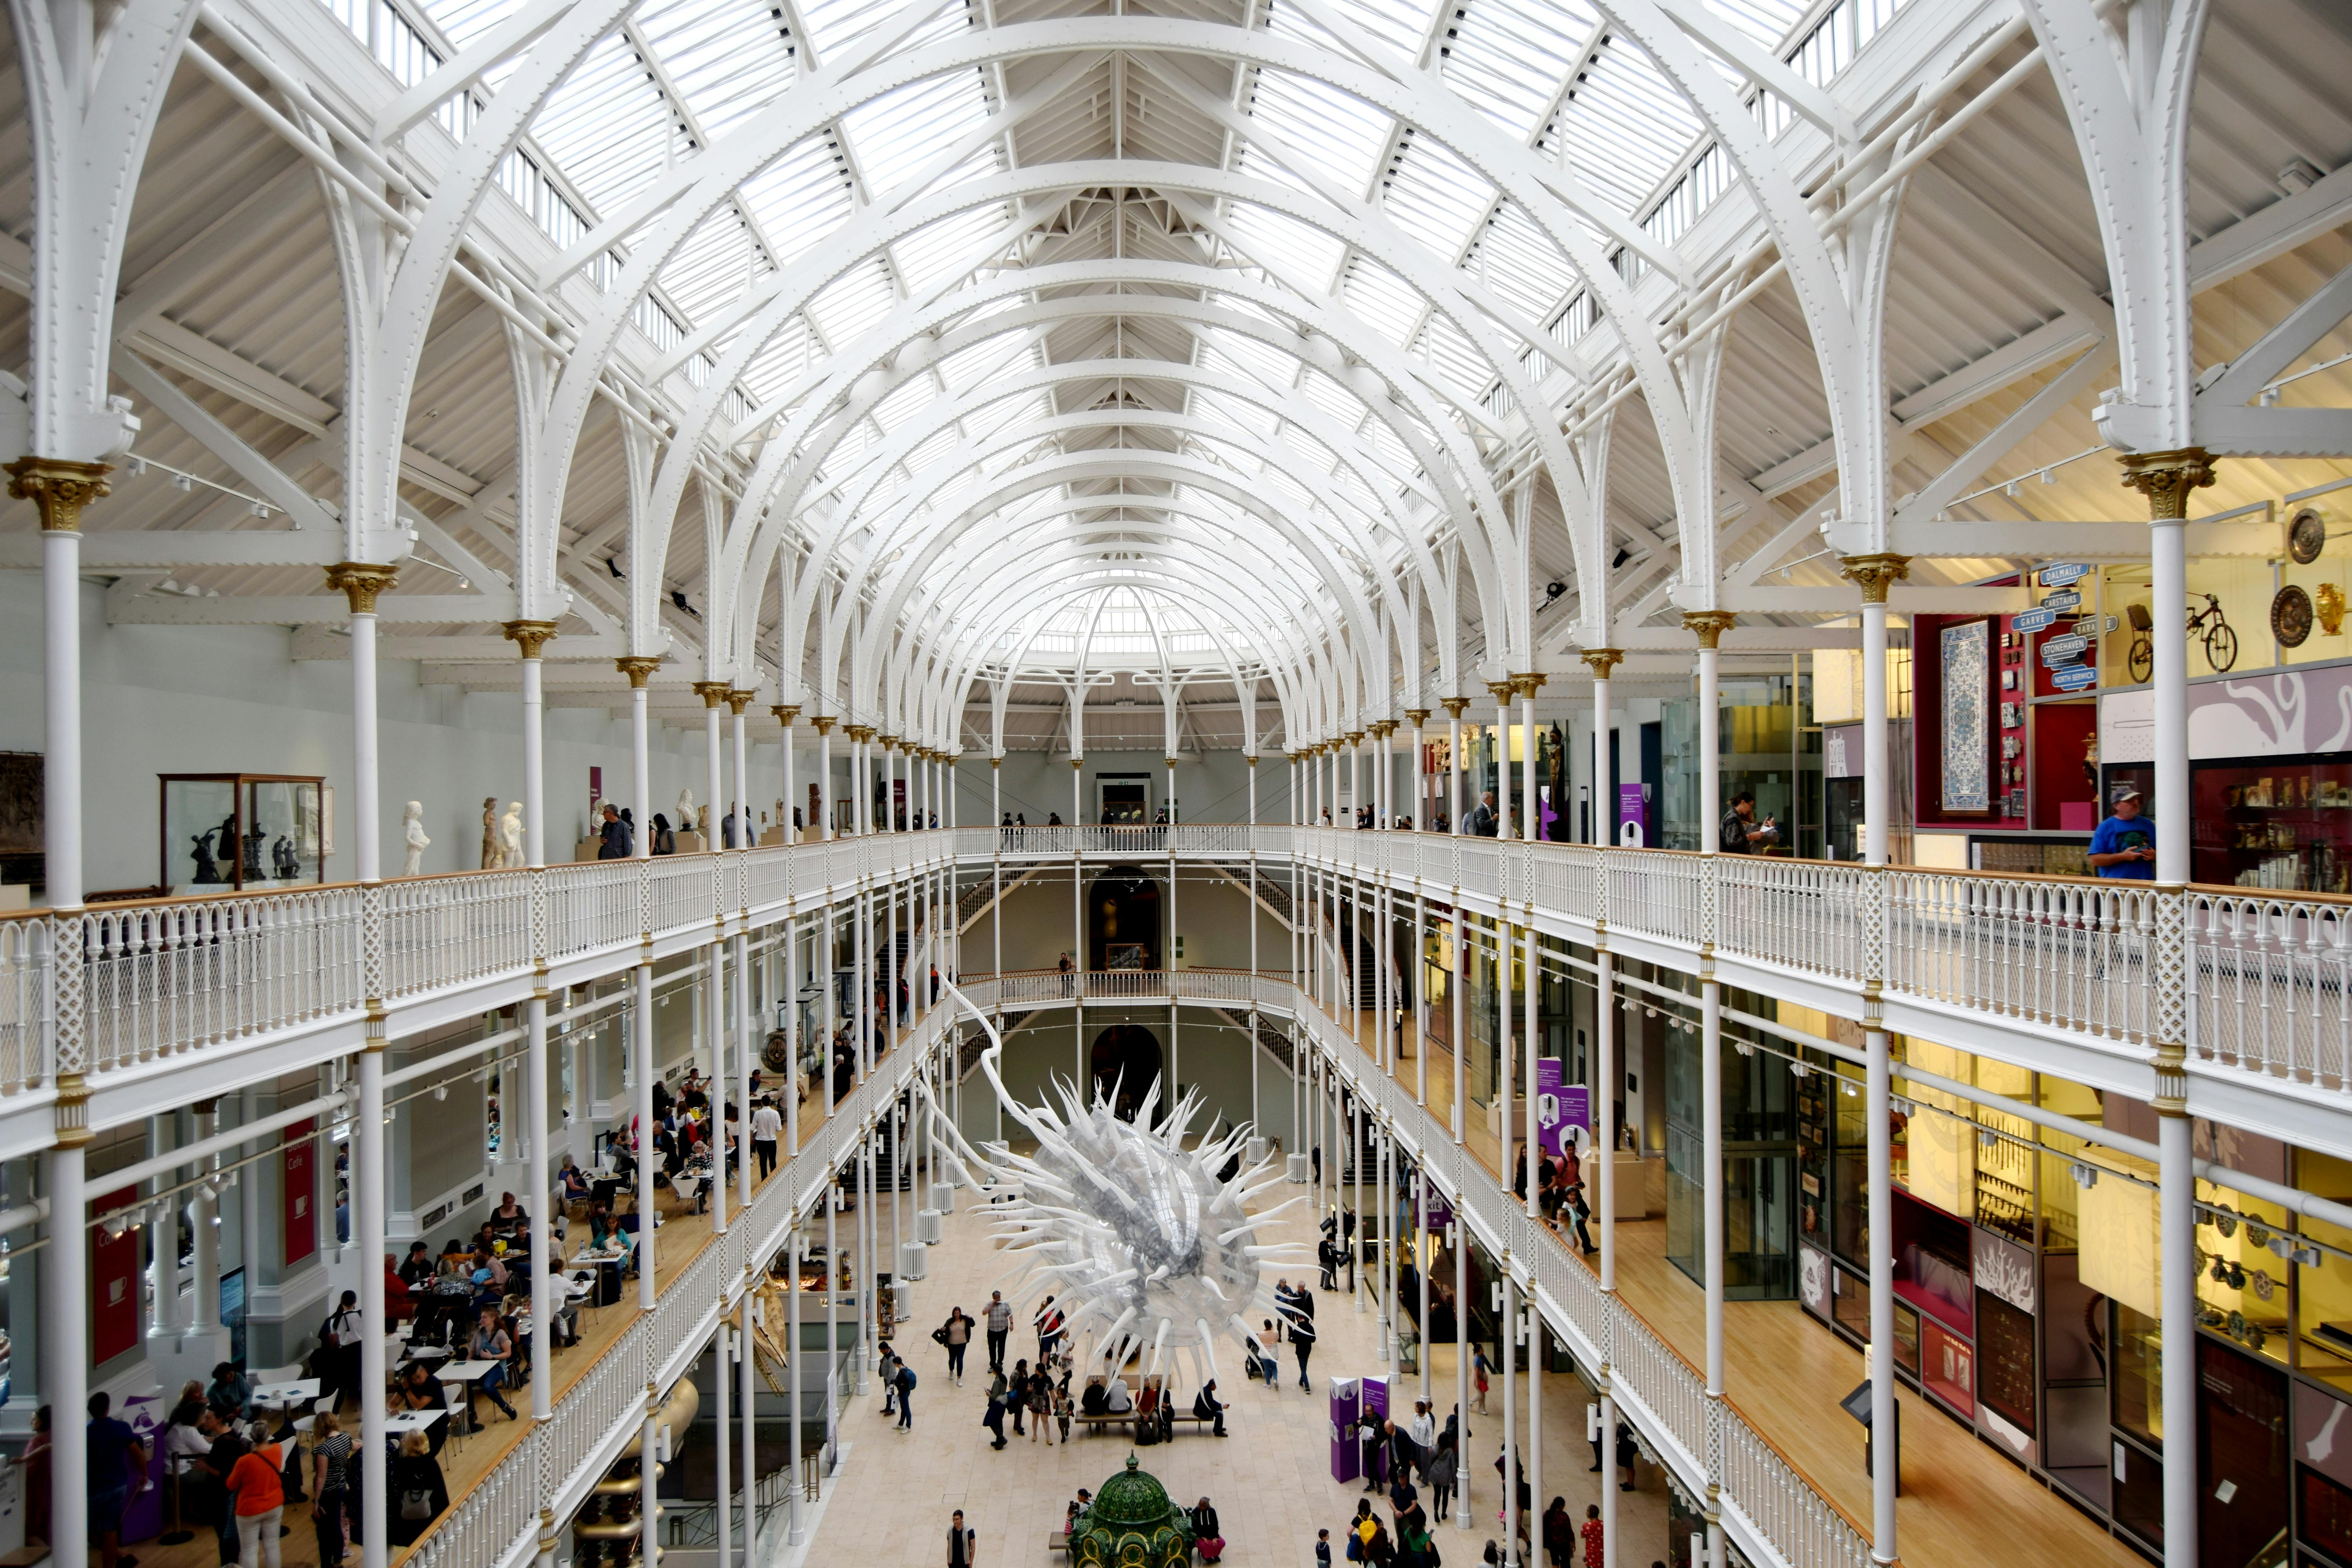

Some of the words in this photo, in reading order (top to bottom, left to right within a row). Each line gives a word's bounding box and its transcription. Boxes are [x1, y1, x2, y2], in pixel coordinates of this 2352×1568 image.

[2047, 564, 2082, 581] DALMALLY
[2044, 595, 2077, 608] CARSTAIRS
[2020, 614, 2045, 626] GARVE
[2077, 620, 2111, 634] BARAE
[2044, 639, 2084, 654] STONEHAVEN
[2054, 674, 2071, 684] NORTH
[2072, 671, 2094, 681] BERWICK
[289, 1154, 303, 1170] Café
[1428, 1201, 1440, 1210] xit
